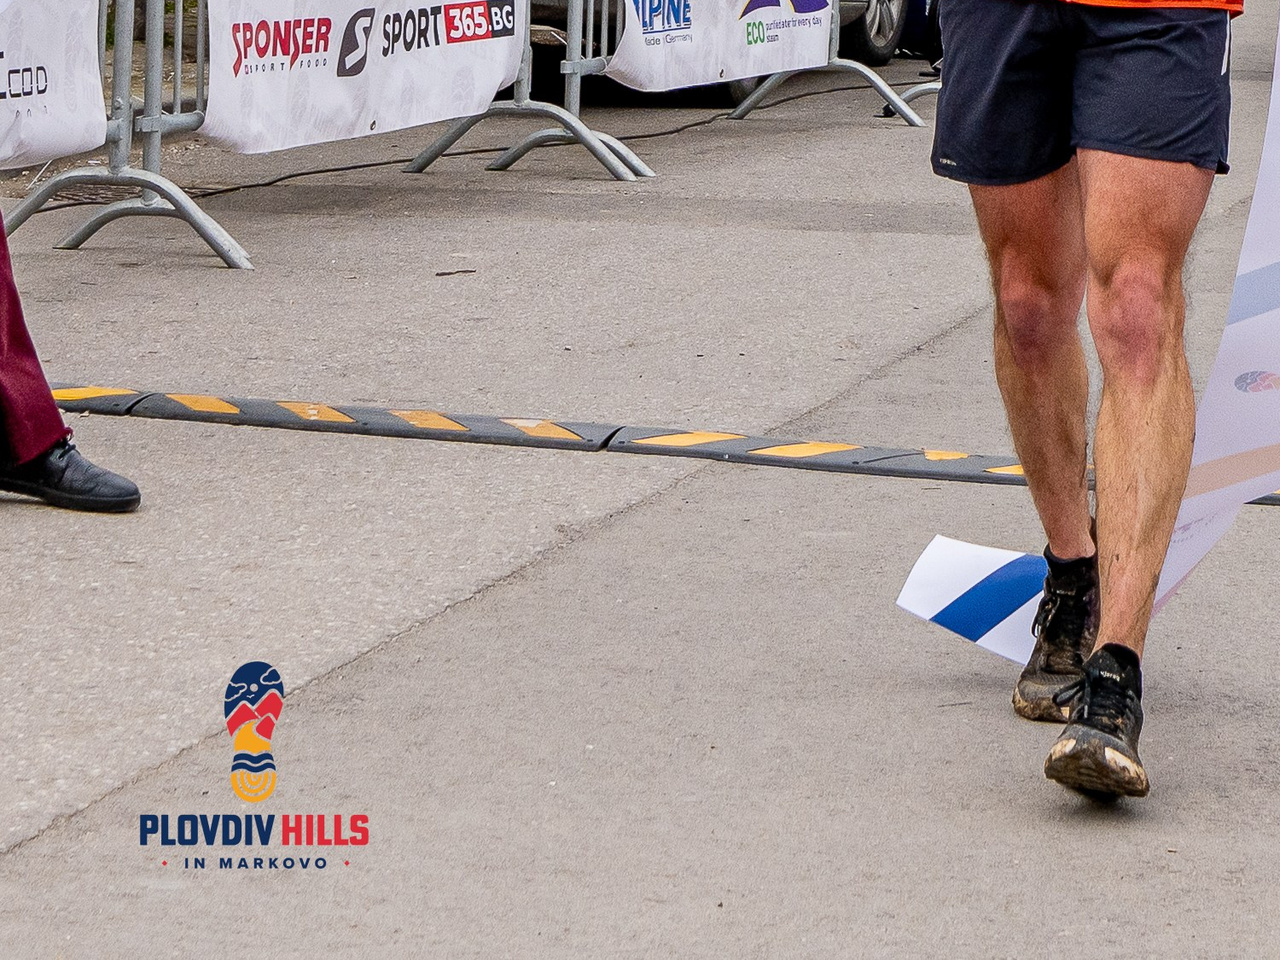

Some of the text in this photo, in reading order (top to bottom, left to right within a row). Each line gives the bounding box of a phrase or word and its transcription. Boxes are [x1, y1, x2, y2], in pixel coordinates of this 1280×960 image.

[747, 21, 765, 45] ECO
[232, 17, 332, 78] SPONSER
[300, 58, 328, 69] FOOD
